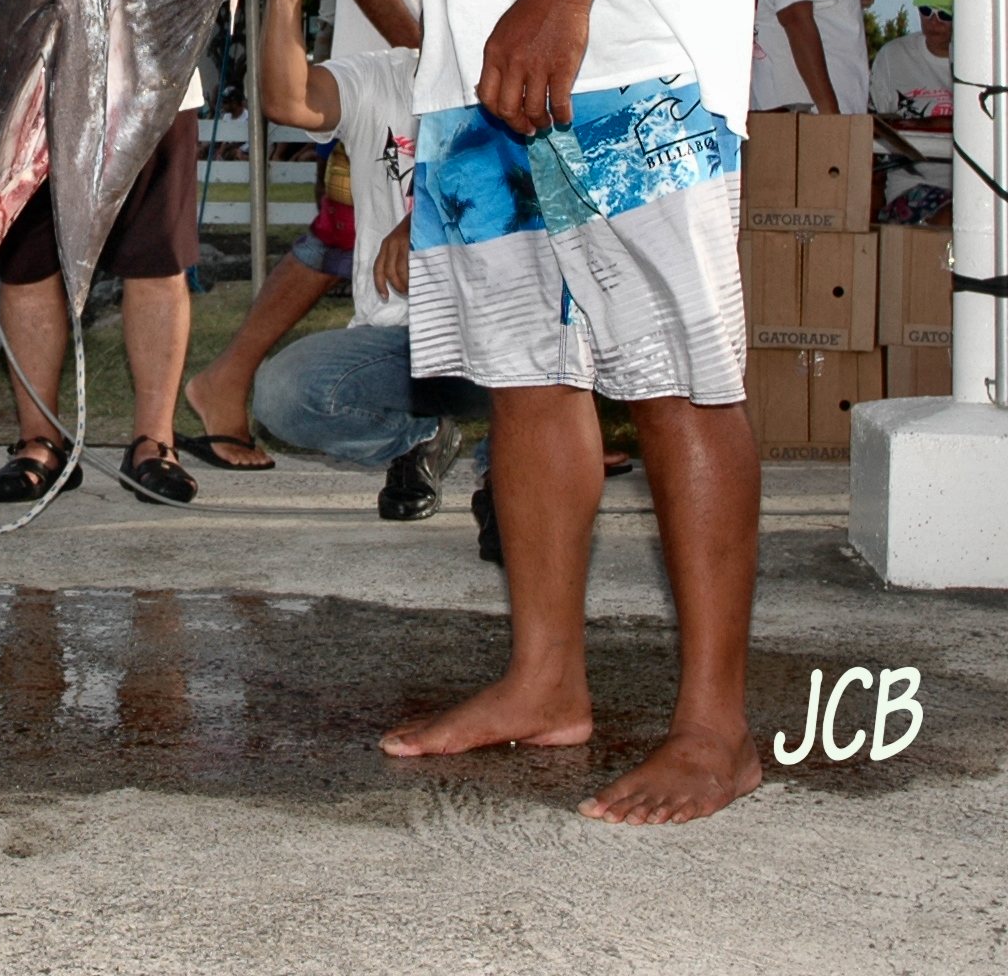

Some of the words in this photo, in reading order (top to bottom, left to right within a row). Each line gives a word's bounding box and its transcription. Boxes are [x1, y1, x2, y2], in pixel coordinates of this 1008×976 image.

[645, 135, 715, 170] BILLABO
[752, 213, 834, 226] GATORADE
[758, 331, 840, 346] GATORADE
[908, 330, 952, 343] GATO
